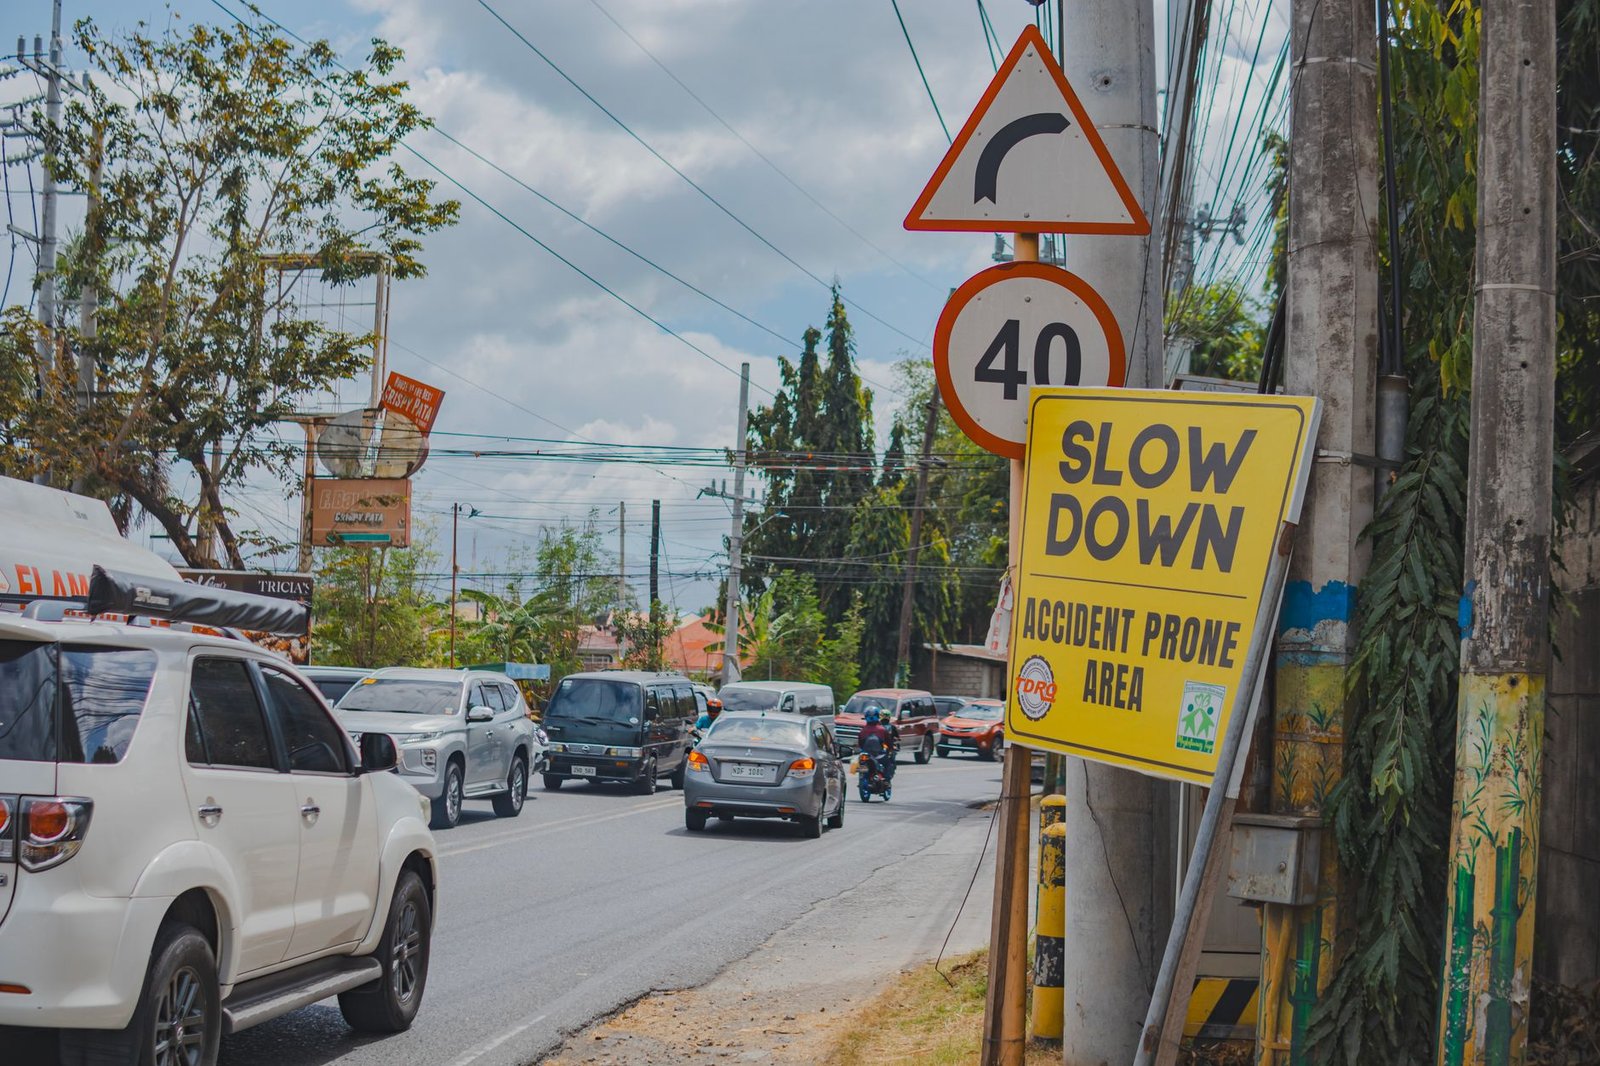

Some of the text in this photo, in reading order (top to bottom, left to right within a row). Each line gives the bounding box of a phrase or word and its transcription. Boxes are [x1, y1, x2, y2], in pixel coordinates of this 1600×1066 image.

[974, 319, 1081, 400] 40
[411, 398, 433, 422] PATA
[1058, 420, 1258, 495] SLOW
[1045, 492, 1246, 573] DOWN
[1022, 596, 1241, 668] ACCIDENT PRONE
[1015, 676, 1058, 703] TDRO
[1082, 659, 1144, 713] AREA
